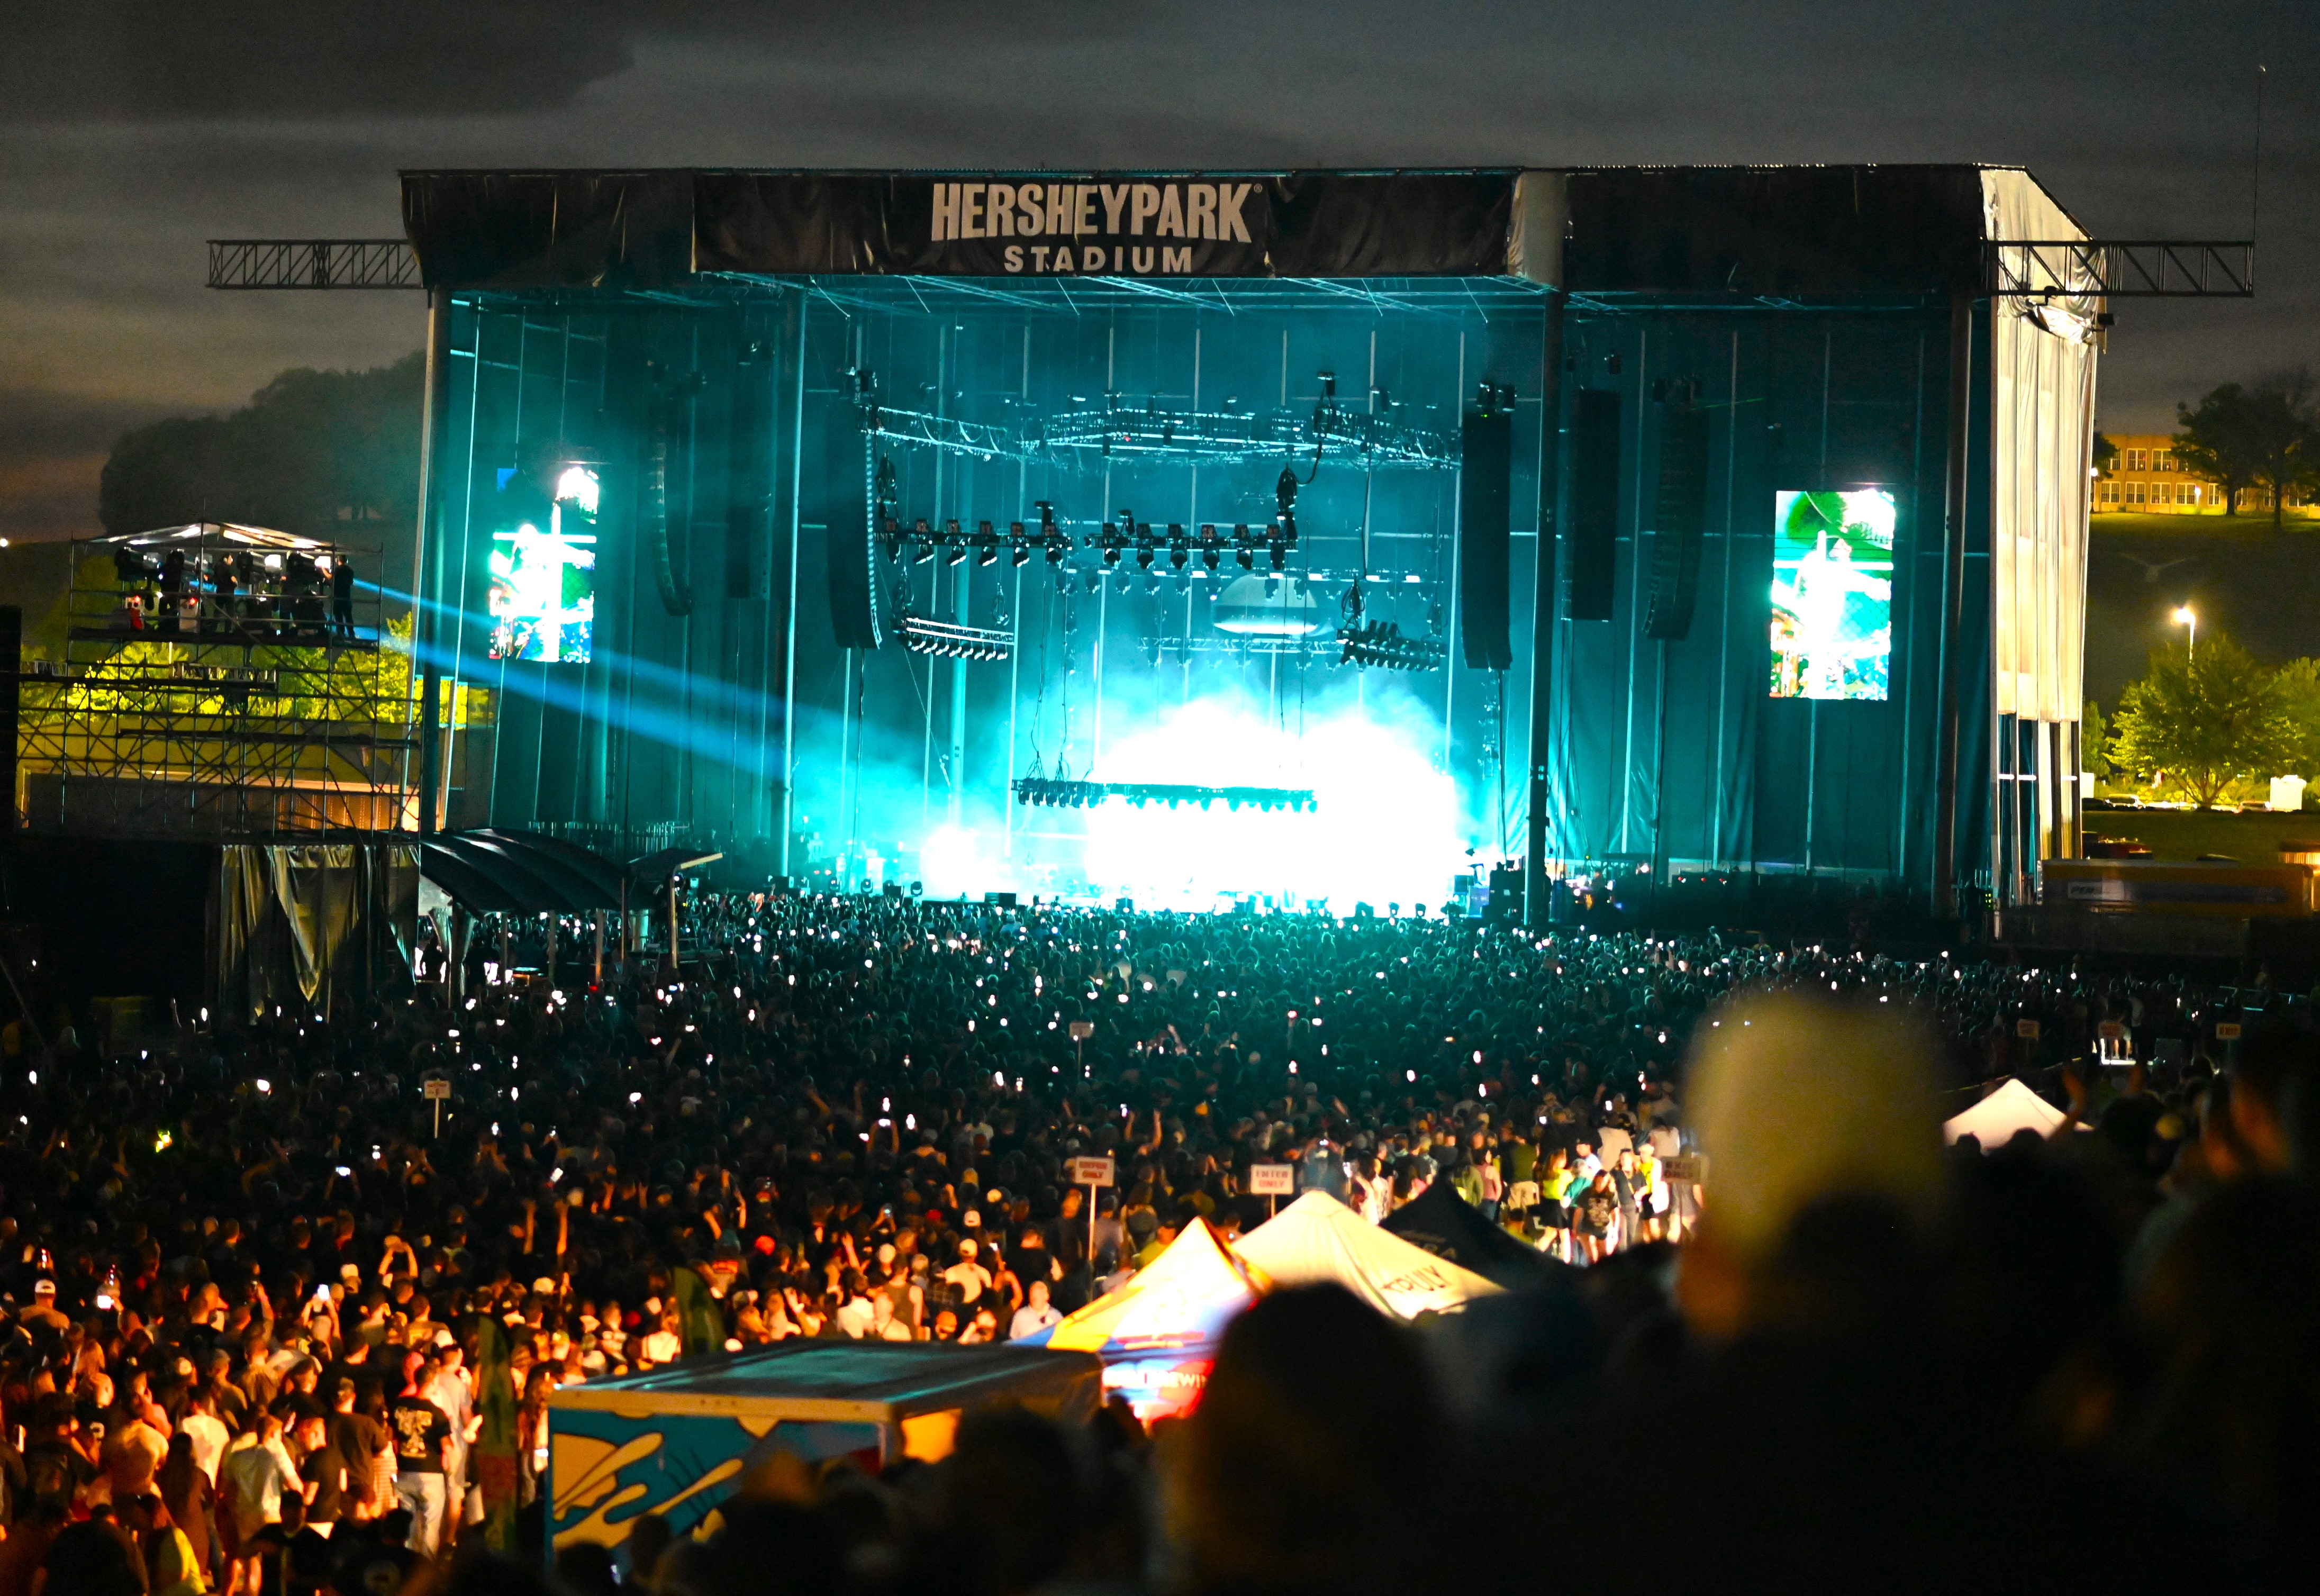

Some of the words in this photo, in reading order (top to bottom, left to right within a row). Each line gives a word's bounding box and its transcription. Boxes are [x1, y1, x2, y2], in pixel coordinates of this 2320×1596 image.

[931, 183, 1252, 243] HERSHEYPARK
[1003, 246, 1192, 273] STADIUM
[1382, 1264, 1452, 1295] TRULY
